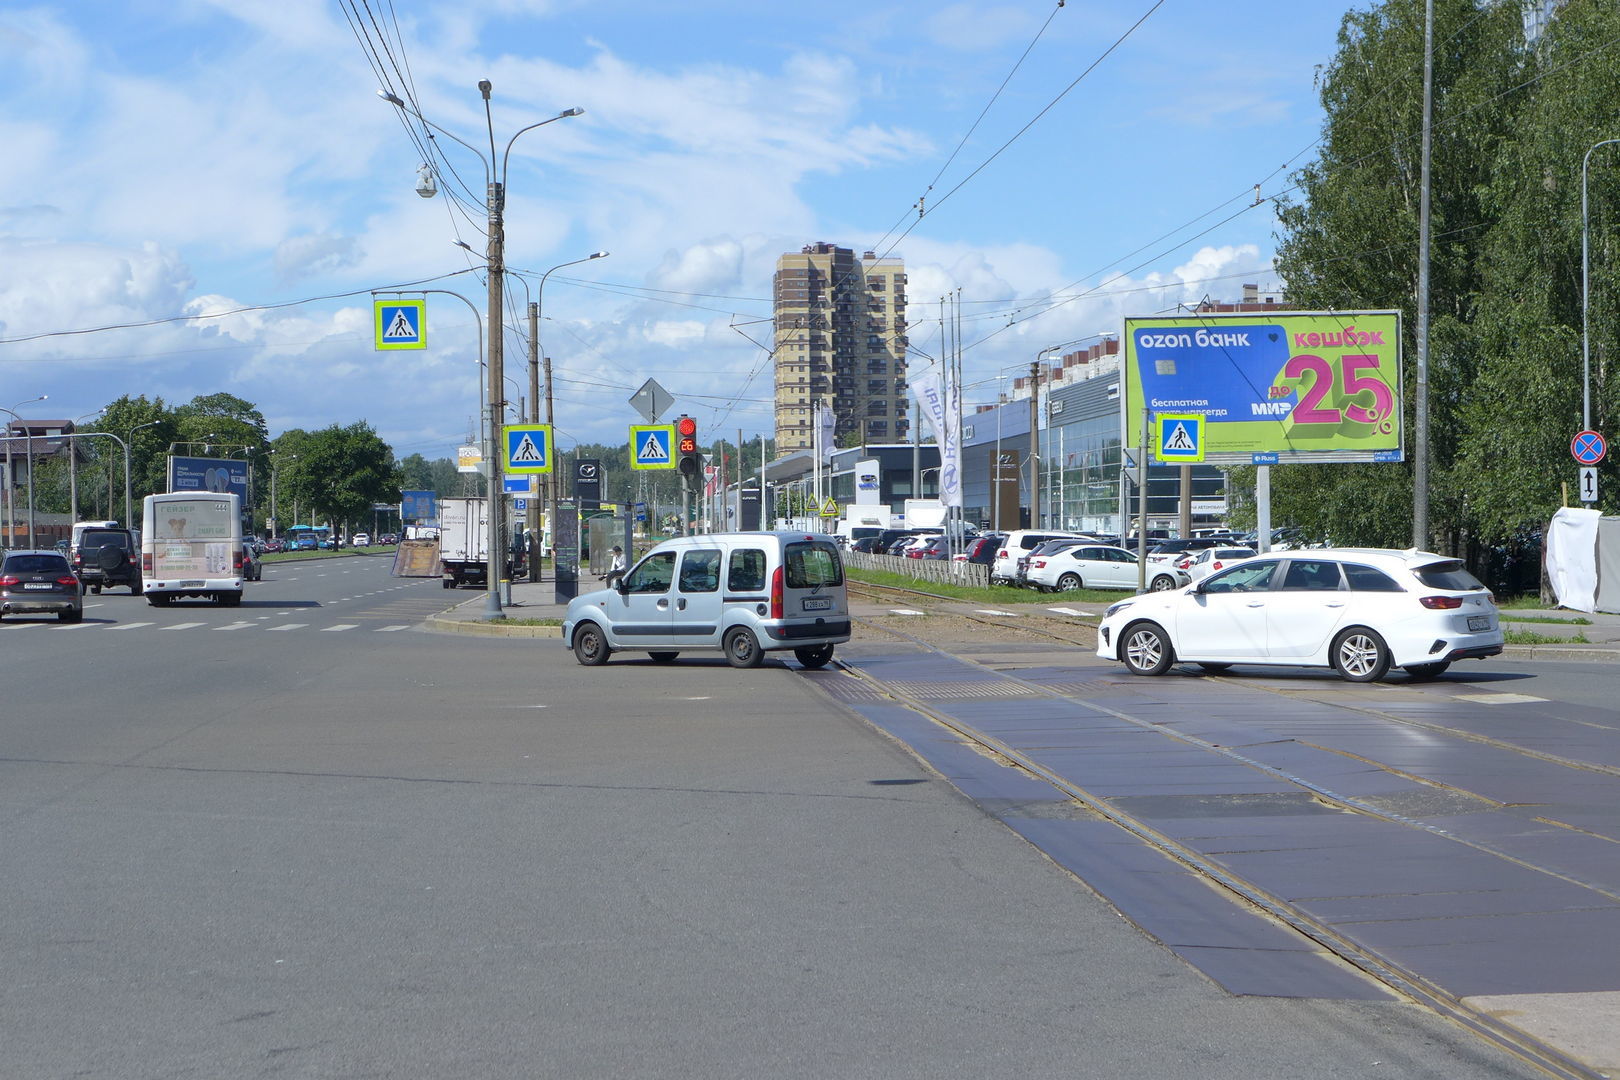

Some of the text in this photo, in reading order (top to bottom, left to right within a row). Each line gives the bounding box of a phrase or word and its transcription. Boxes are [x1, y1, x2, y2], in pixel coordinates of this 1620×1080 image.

[1140, 329, 1250, 348] ozon банк
[1294, 326, 1385, 349] кешбэк
[1269, 385, 1291, 398] до
[1151, 398, 1208, 407] бесплатная
[1251, 403, 1293, 415] МИР
[681, 440, 693, 451] 26
